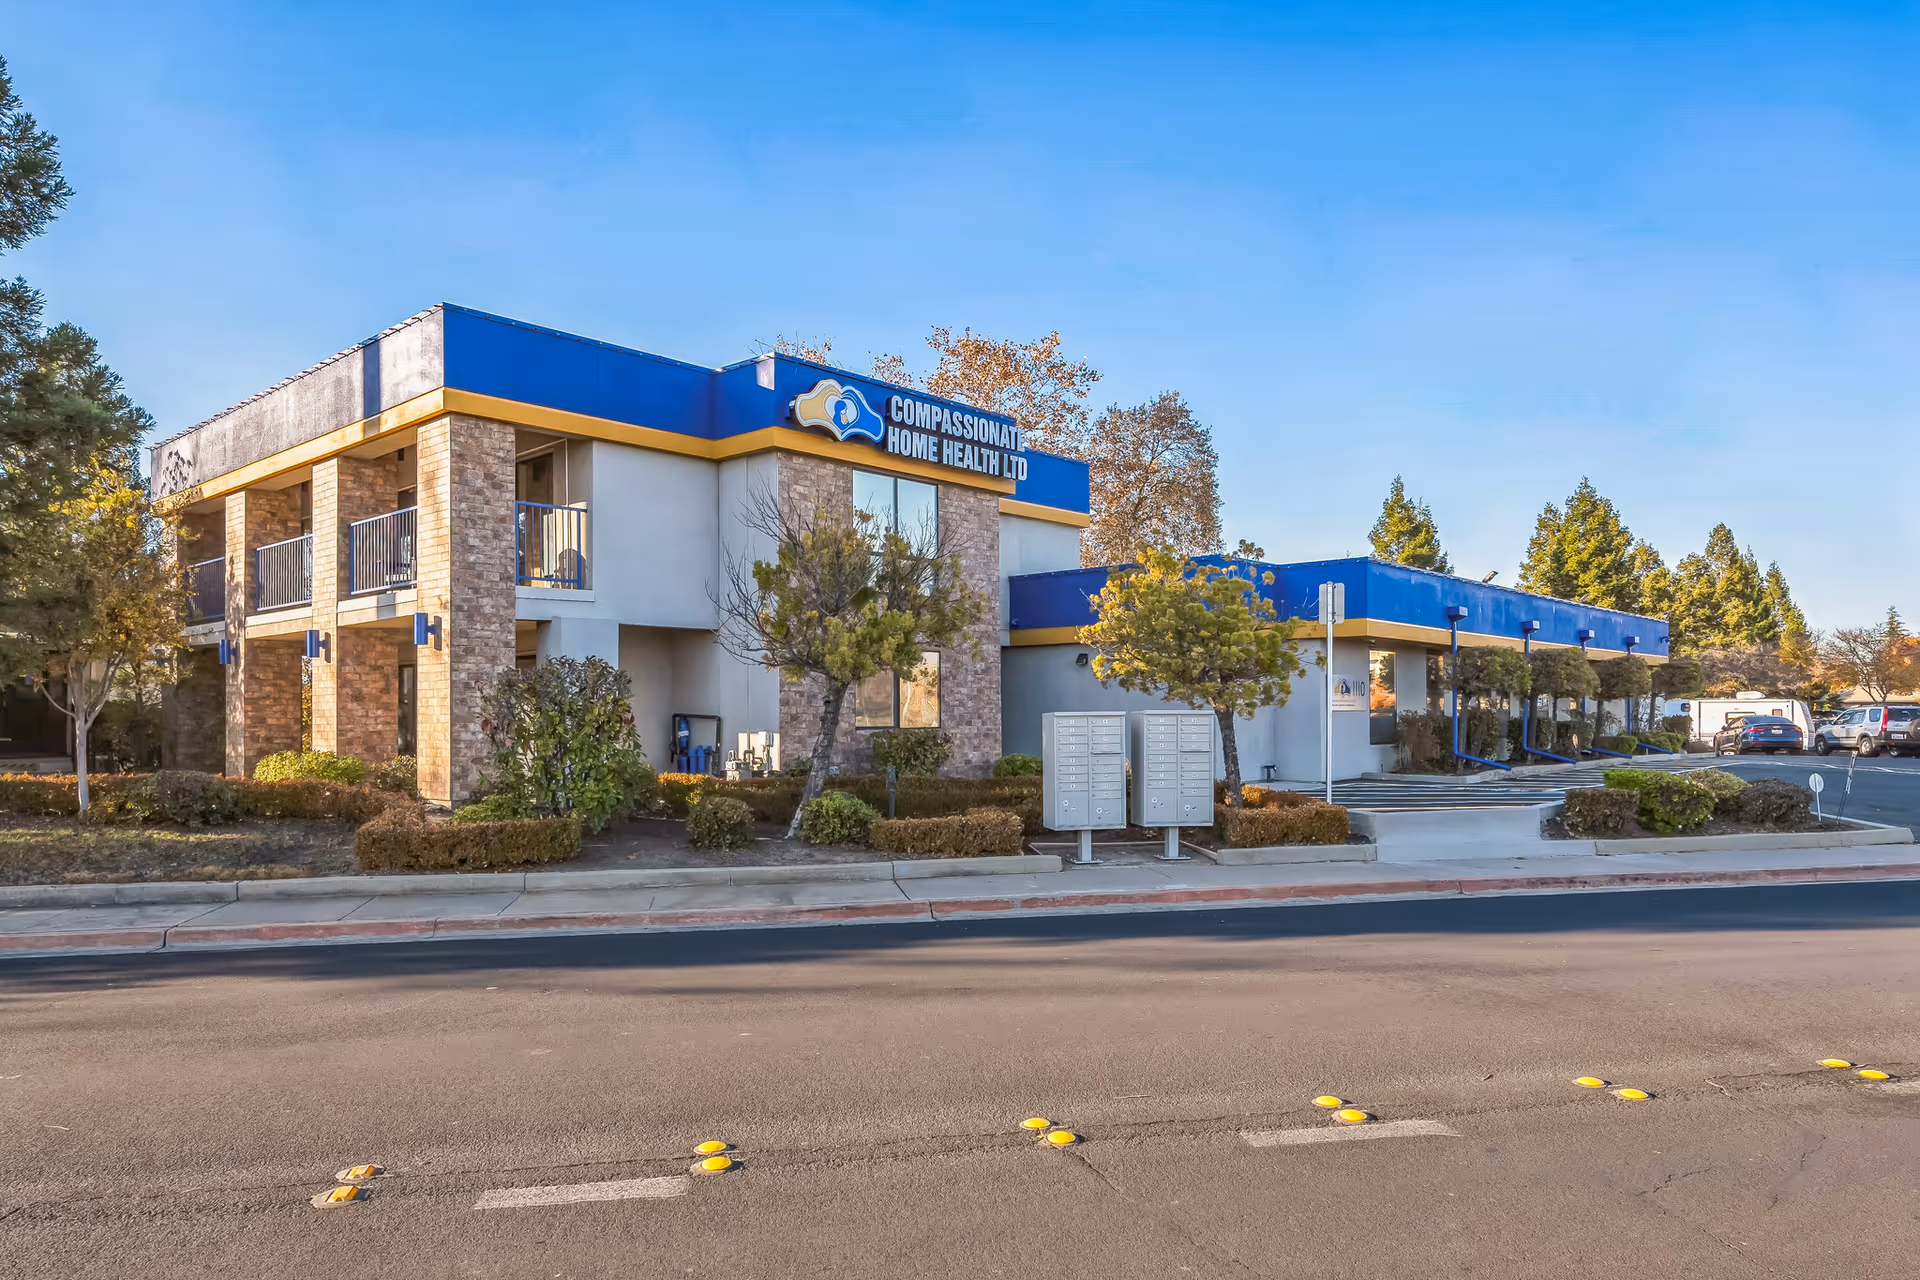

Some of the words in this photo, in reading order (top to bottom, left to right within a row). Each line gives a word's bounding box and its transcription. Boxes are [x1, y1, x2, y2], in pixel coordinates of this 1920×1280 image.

[890, 395, 1026, 452] COMPASSIONATE
[888, 426, 939, 463] HOME
[942, 439, 1000, 476] HEALTH
[1003, 453, 1028, 481] LTD
